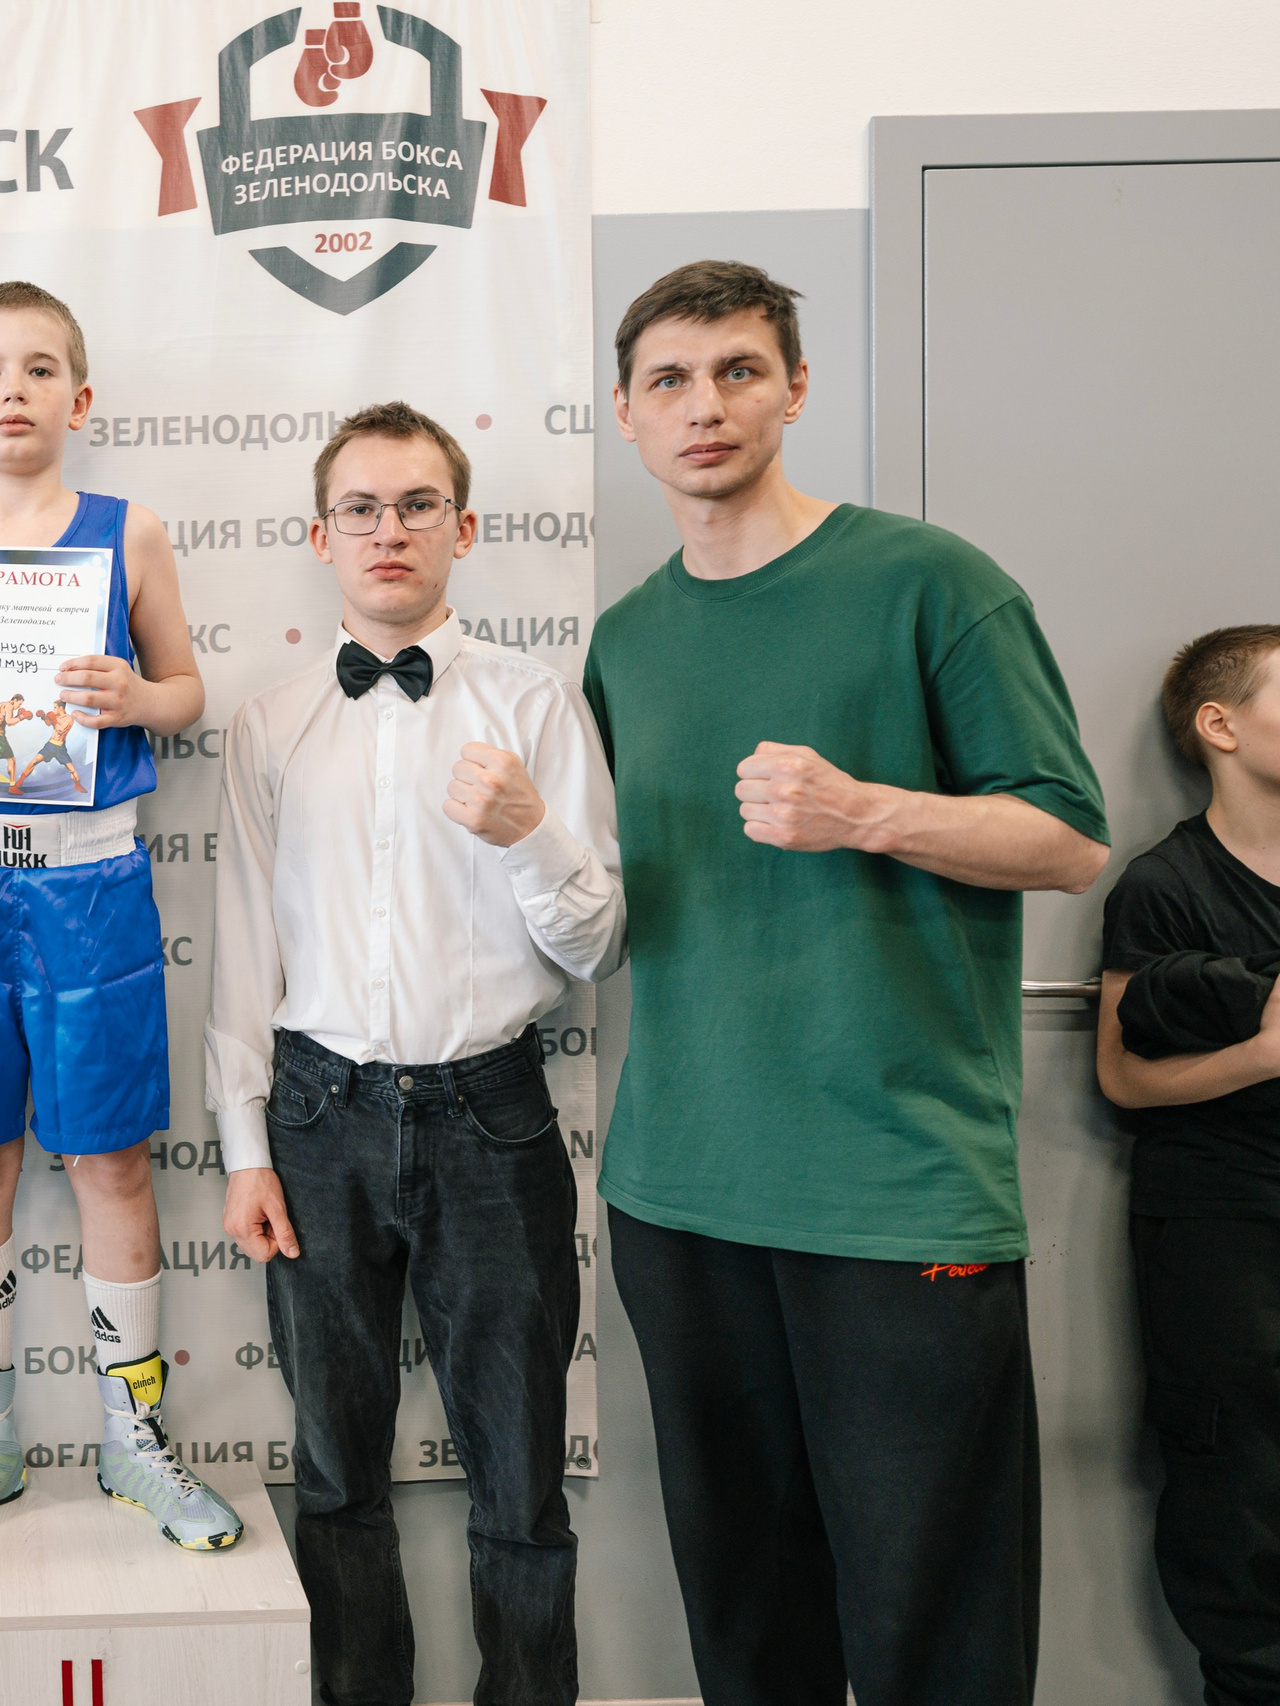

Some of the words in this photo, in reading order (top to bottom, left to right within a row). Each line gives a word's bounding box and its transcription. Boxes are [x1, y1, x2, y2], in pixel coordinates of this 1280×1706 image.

[220, 141, 373, 175] ФЕДЕРАЦИЯ
[381, 140, 464, 171] БОКСА
[233, 172, 451, 206] ЗЕЛЕНОДОЛЬСКА
[314, 231, 373, 254] 2002
[12, 604, 53, 613] матчевой
[56, 606, 90, 615] встречи
[133, 1375, 156, 1390] clinch
